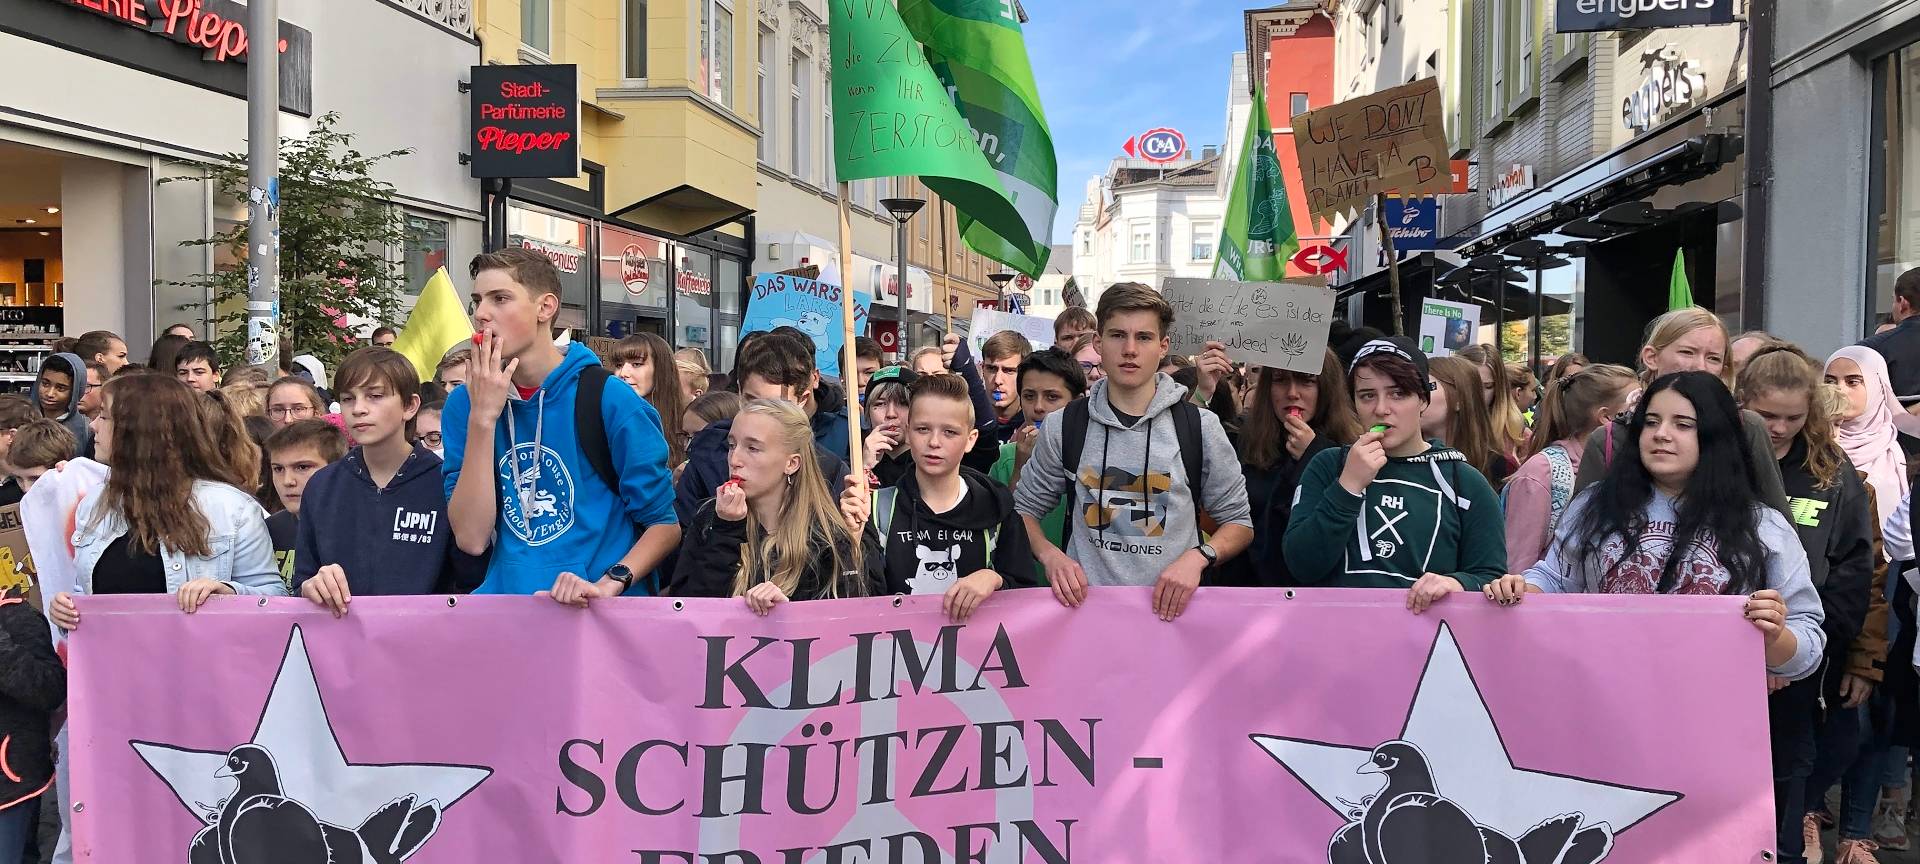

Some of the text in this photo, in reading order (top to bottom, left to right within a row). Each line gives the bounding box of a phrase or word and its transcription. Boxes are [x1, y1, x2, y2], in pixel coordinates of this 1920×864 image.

[501, 82, 550, 98] Stadt-
[898, 76, 924, 101] IHR
[481, 103, 566, 119] Parfümerie
[477, 126, 570, 155] Pieper
[1308, 112, 1351, 144] WE
[1147, 137, 1177, 153] C&A
[1313, 140, 1402, 184] HAVE A
[1310, 155, 1437, 214] PLANET B
[755, 276, 786, 300] DAS
[1381, 494, 1404, 510] RH
[1121, 543, 1163, 556] JONES
[694, 620, 1030, 712] KLIMA
[555, 717, 1102, 819] SCHÜTZEN
